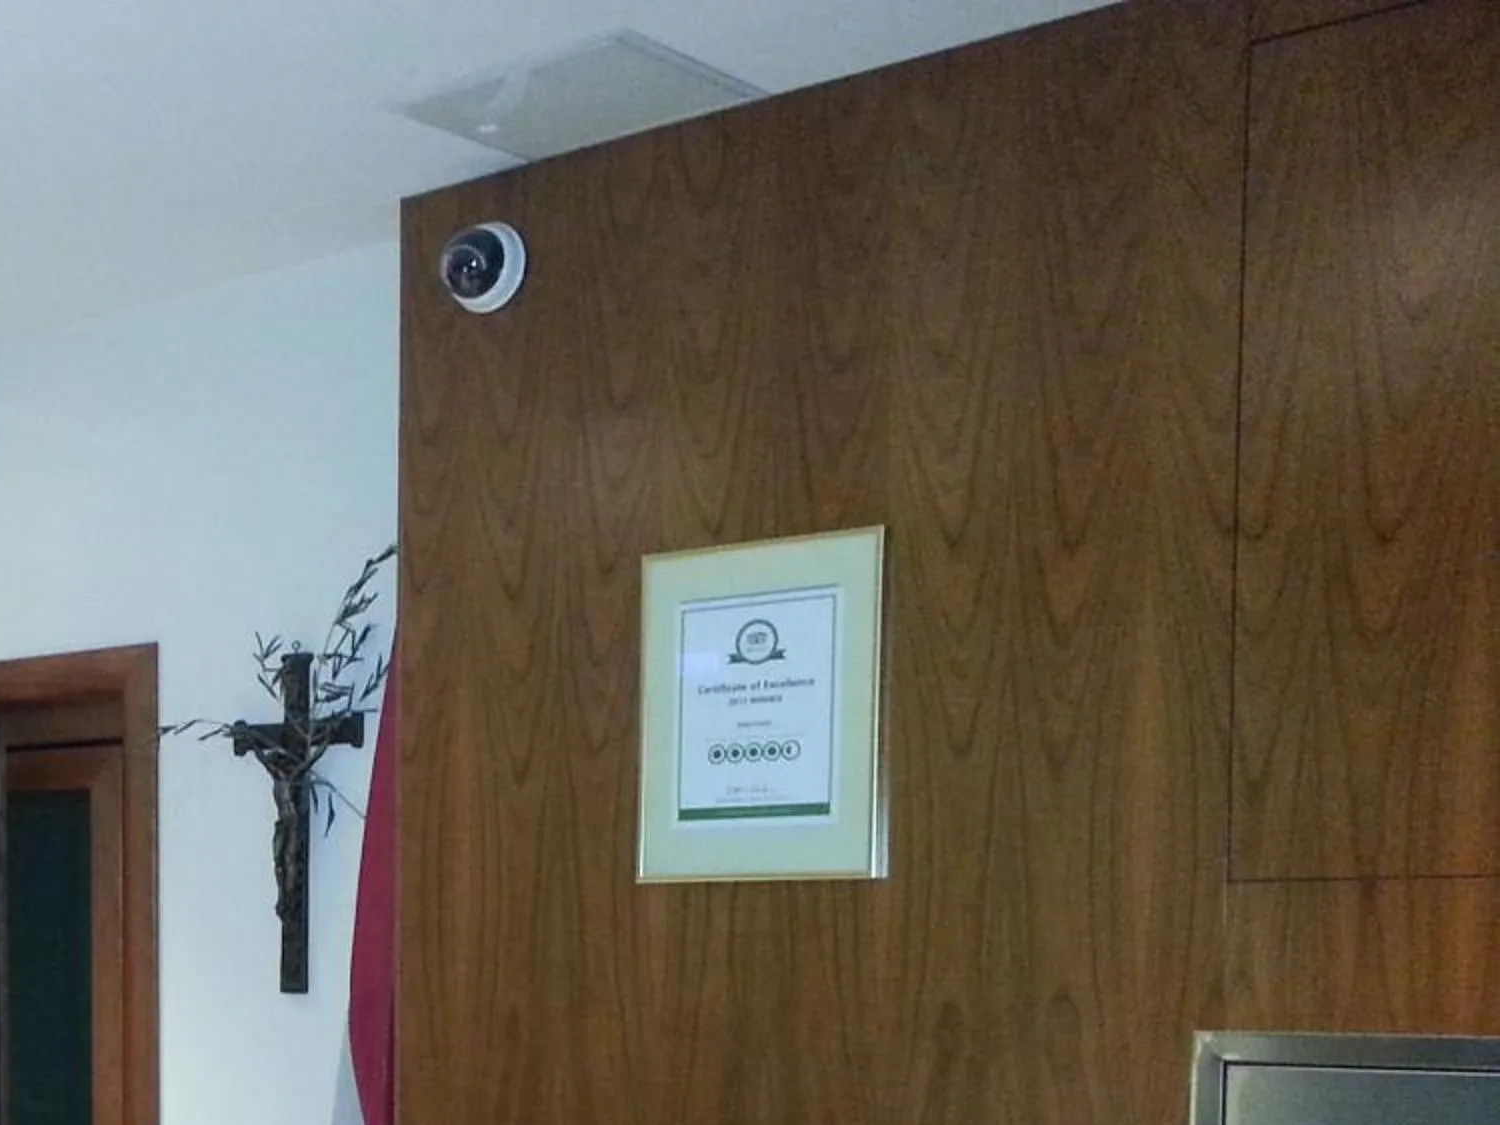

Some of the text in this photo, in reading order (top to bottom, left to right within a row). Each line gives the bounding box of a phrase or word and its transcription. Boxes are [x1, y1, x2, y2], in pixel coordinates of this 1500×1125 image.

[698, 678, 815, 695] Certificate of Excellence
